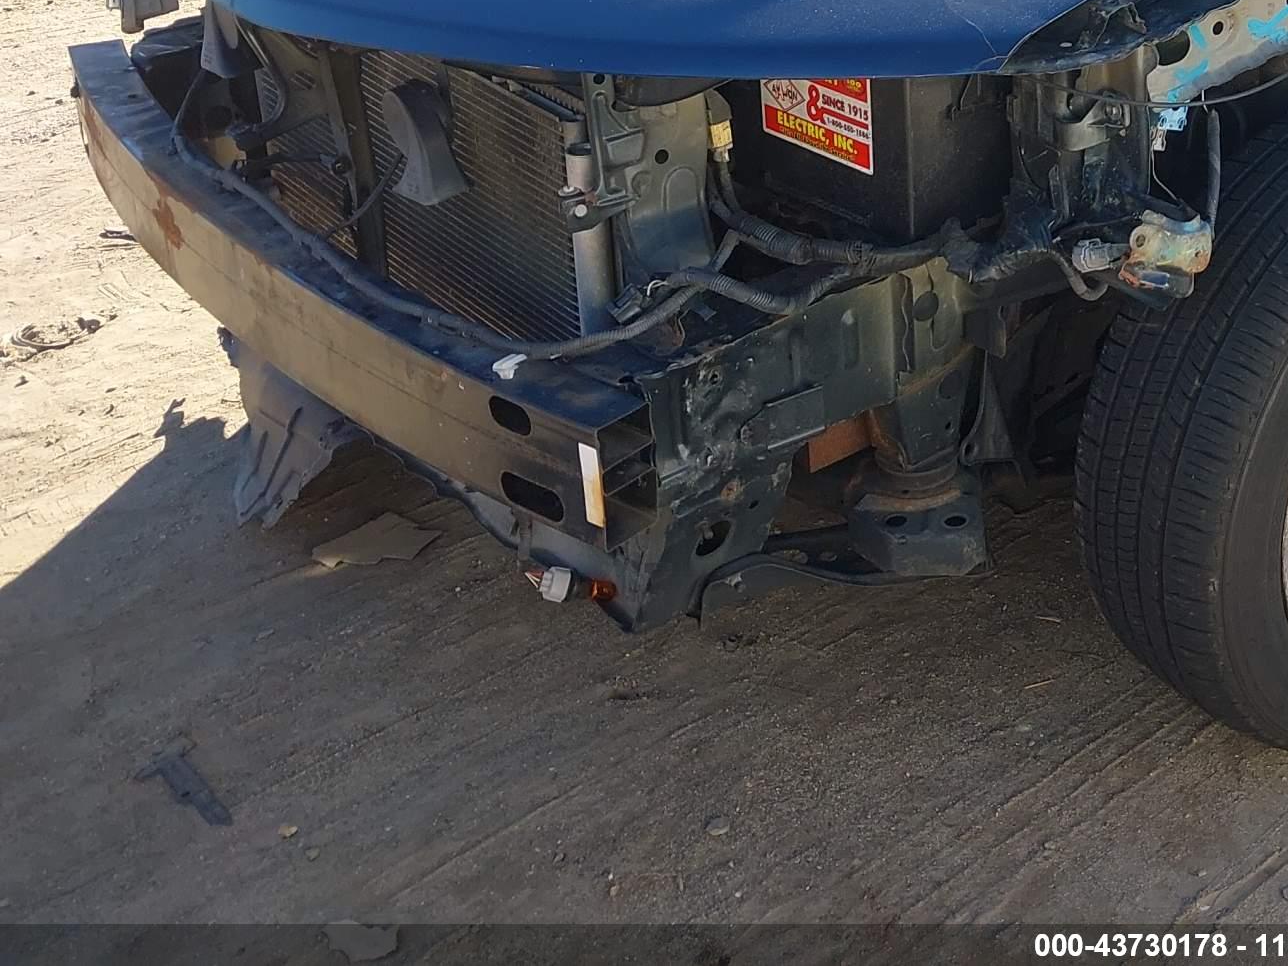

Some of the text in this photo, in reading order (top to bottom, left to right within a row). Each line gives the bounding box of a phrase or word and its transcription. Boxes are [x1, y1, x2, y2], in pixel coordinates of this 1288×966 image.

[807, 84, 826, 125] &
[821, 94, 869, 121] SINCE 1915
[777, 110, 829, 145] ELECTRIC,
[833, 134, 858, 155] INC.
